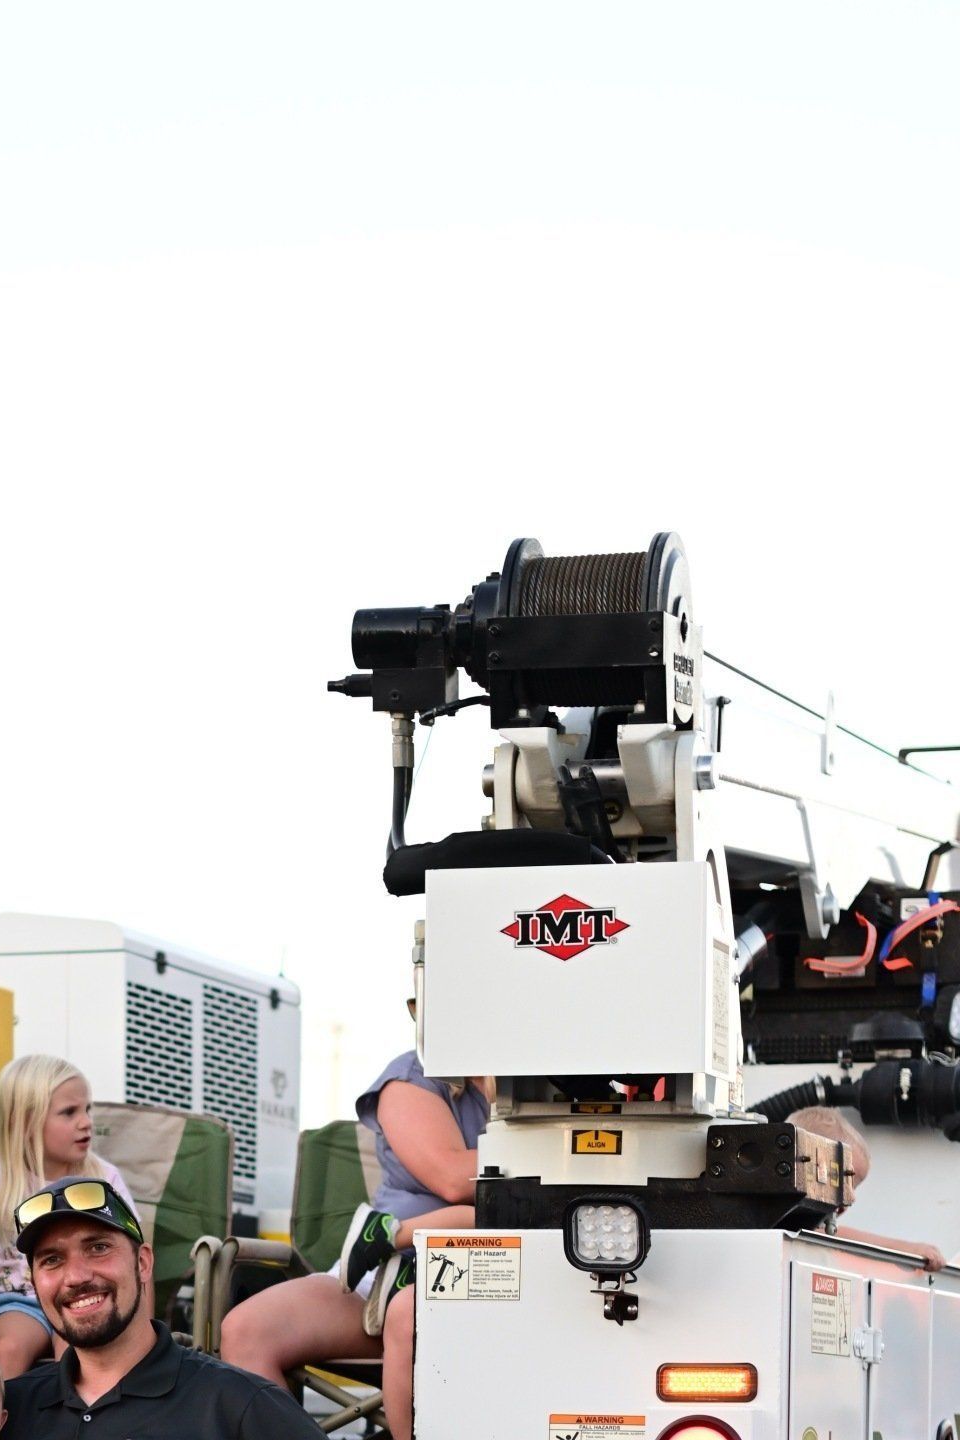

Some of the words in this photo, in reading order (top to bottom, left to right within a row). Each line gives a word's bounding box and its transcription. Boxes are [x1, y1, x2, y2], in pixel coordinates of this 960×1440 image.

[515, 907, 615, 948] IMT
[456, 1239, 502, 1247] WARNING
[584, 1416, 624, 1424] WARNING
